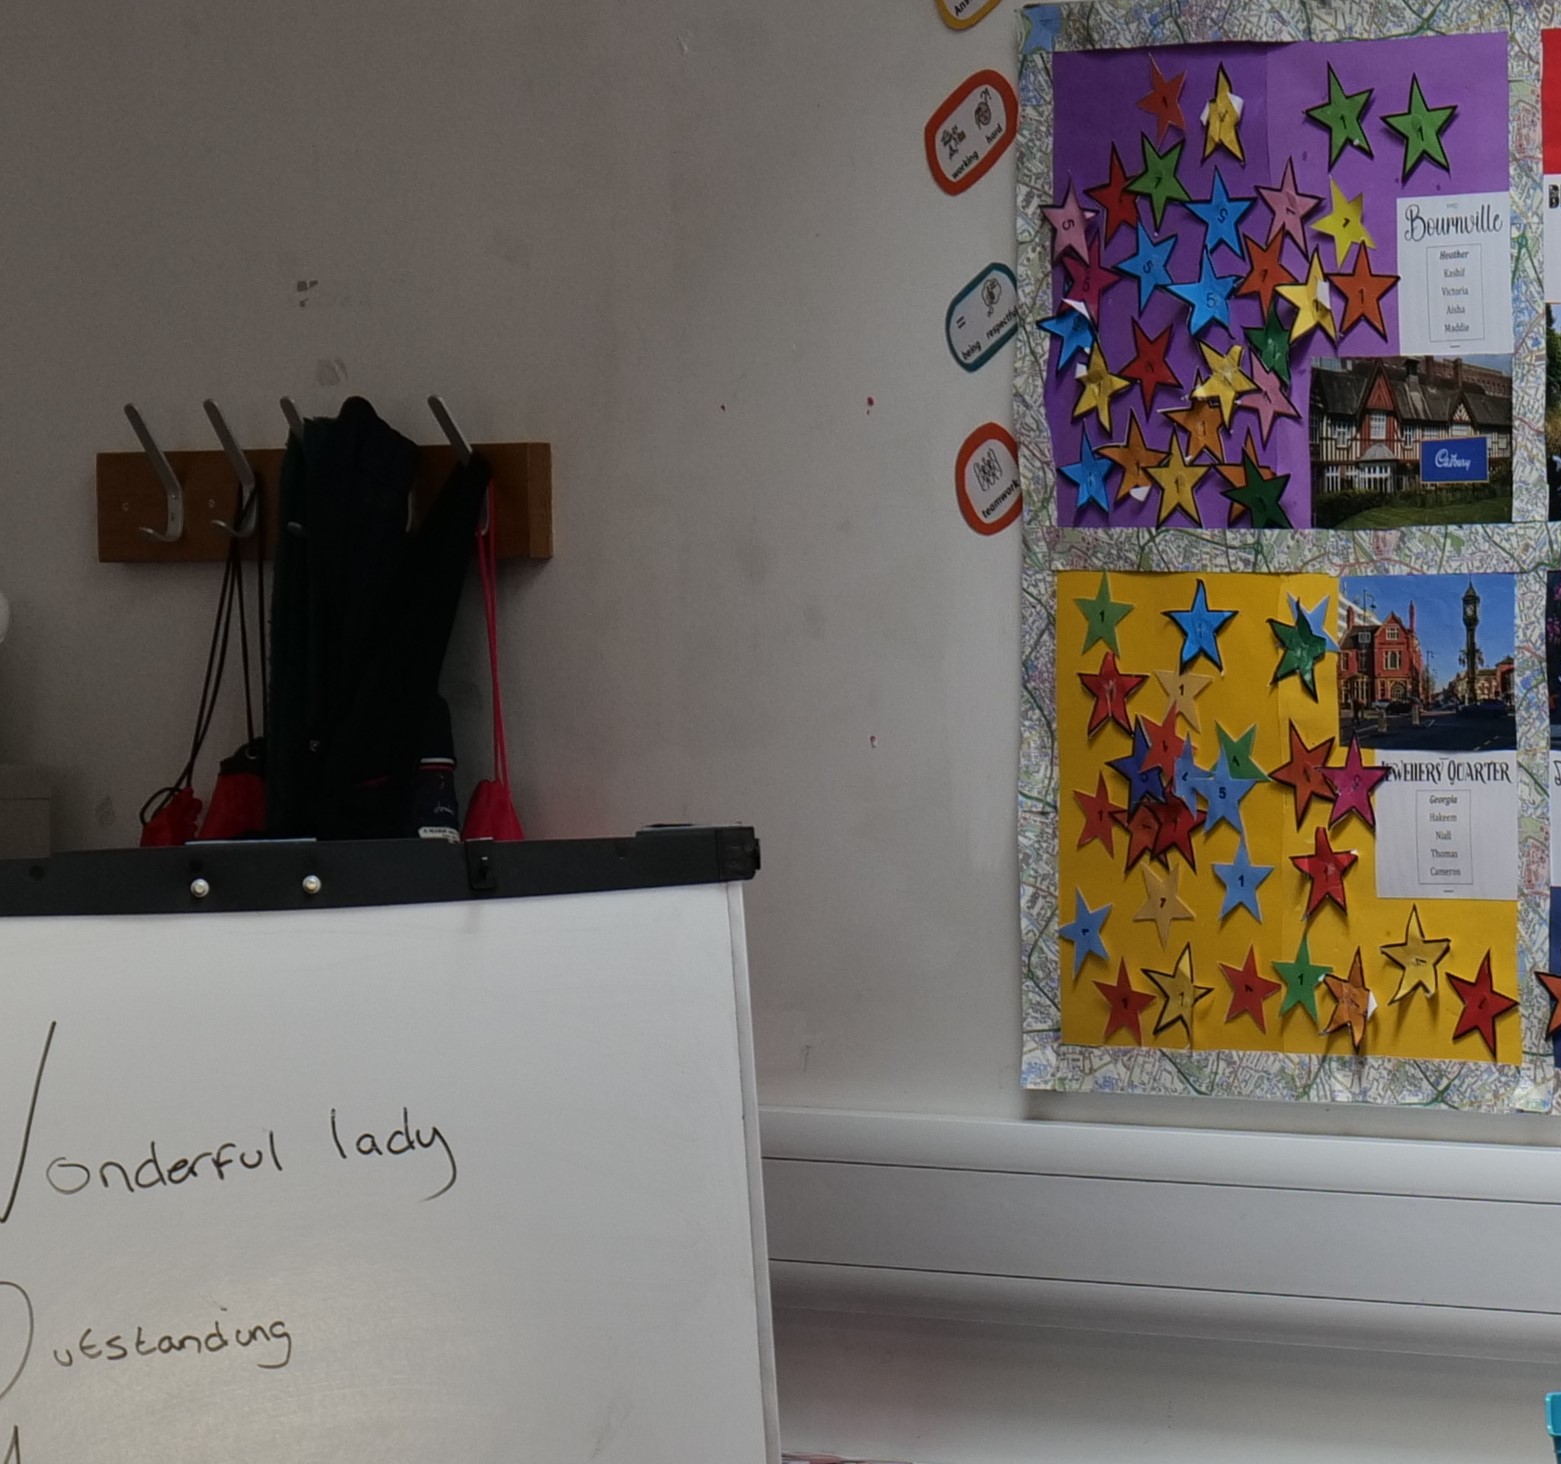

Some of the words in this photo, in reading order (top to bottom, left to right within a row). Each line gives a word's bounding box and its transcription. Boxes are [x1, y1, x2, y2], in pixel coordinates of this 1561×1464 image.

[951, 150, 979, 180] working
[986, 124, 1003, 144] hard
[1217, 208, 1229, 224] 5
[1404, 203, 1503, 242] Bournville
[1062, 218, 1076, 232] 5
[1439, 250, 1469, 260] Heather
[1142, 260, 1154, 274] 5
[1444, 268, 1466, 278] Kashif
[1441, 286, 1469, 297] Victoria
[1206, 292, 1216, 308] 5
[1446, 304, 1466, 314] Aisha
[1444, 323, 1469, 333] Maddie
[961, 339, 982, 361] being
[1435, 448, 1471, 471] Cadbury
[982, 479, 1020, 519] teamwork
[1447, 760, 1513, 785] QUARTER
[1218, 786, 1227, 800] 5
[1429, 795, 1458, 806] Georgia
[1429, 813, 1457, 822] Hakeem
[1435, 831, 1452, 840] Niall
[1430, 849, 1458, 858] Thomas
[1430, 867, 1461, 876] Cameron
[330, 1106, 457, 1202] lady
